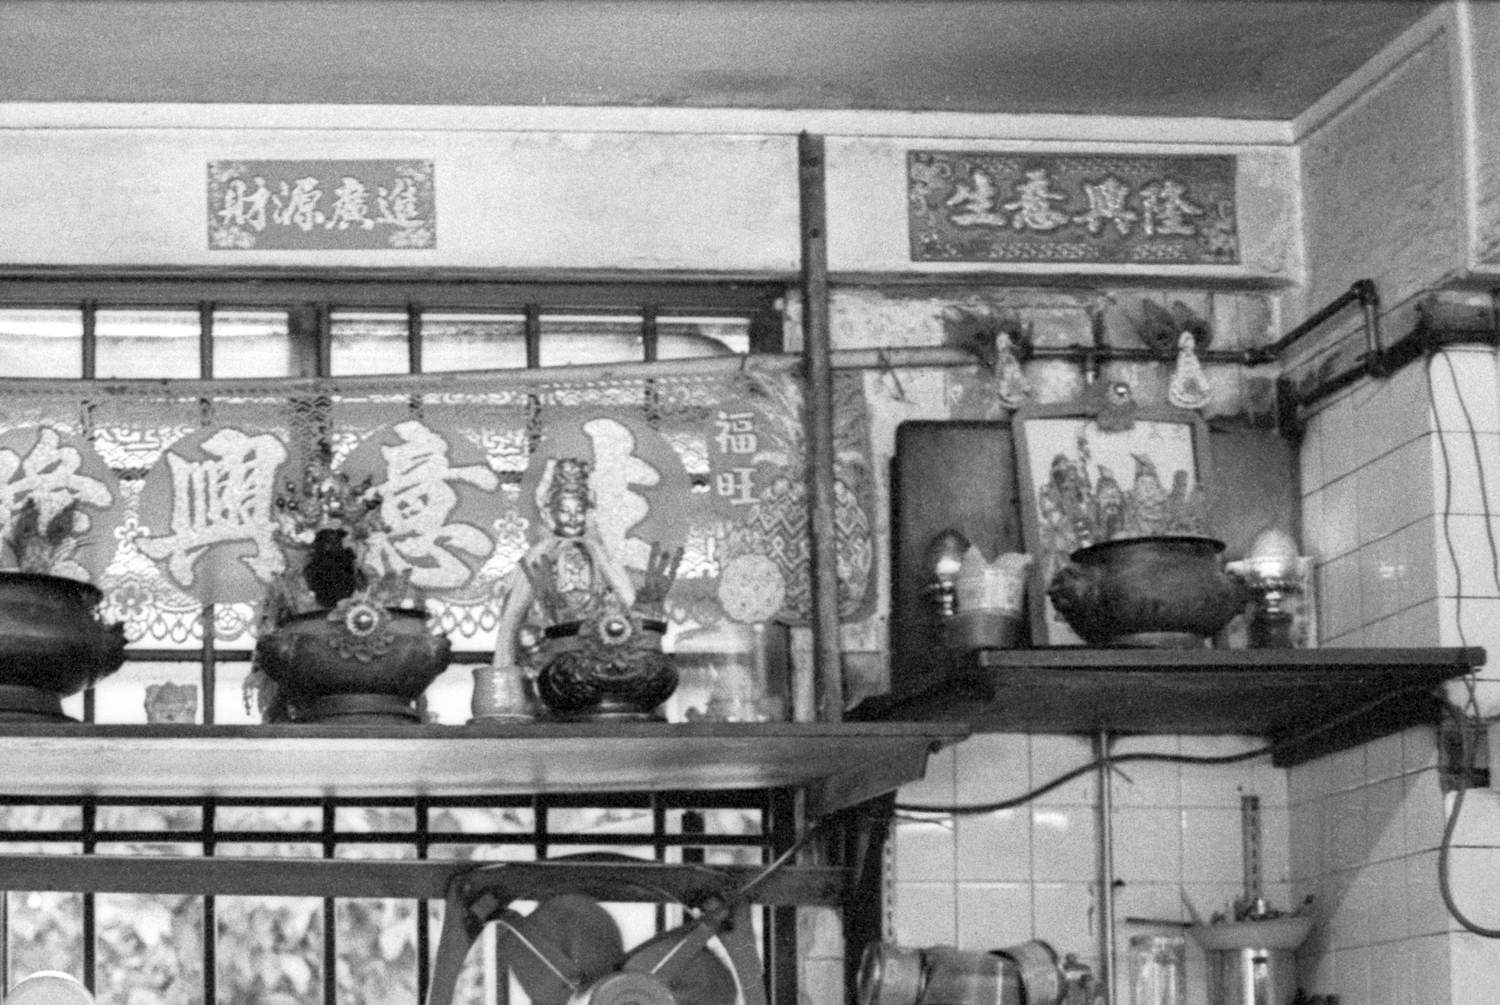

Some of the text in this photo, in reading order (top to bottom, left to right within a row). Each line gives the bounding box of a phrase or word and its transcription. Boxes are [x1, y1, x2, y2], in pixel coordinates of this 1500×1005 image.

[218, 175, 426, 232] 財源廣進
[946, 168, 1204, 237] 生意興隆
[714, 411, 759, 506] 福旺
